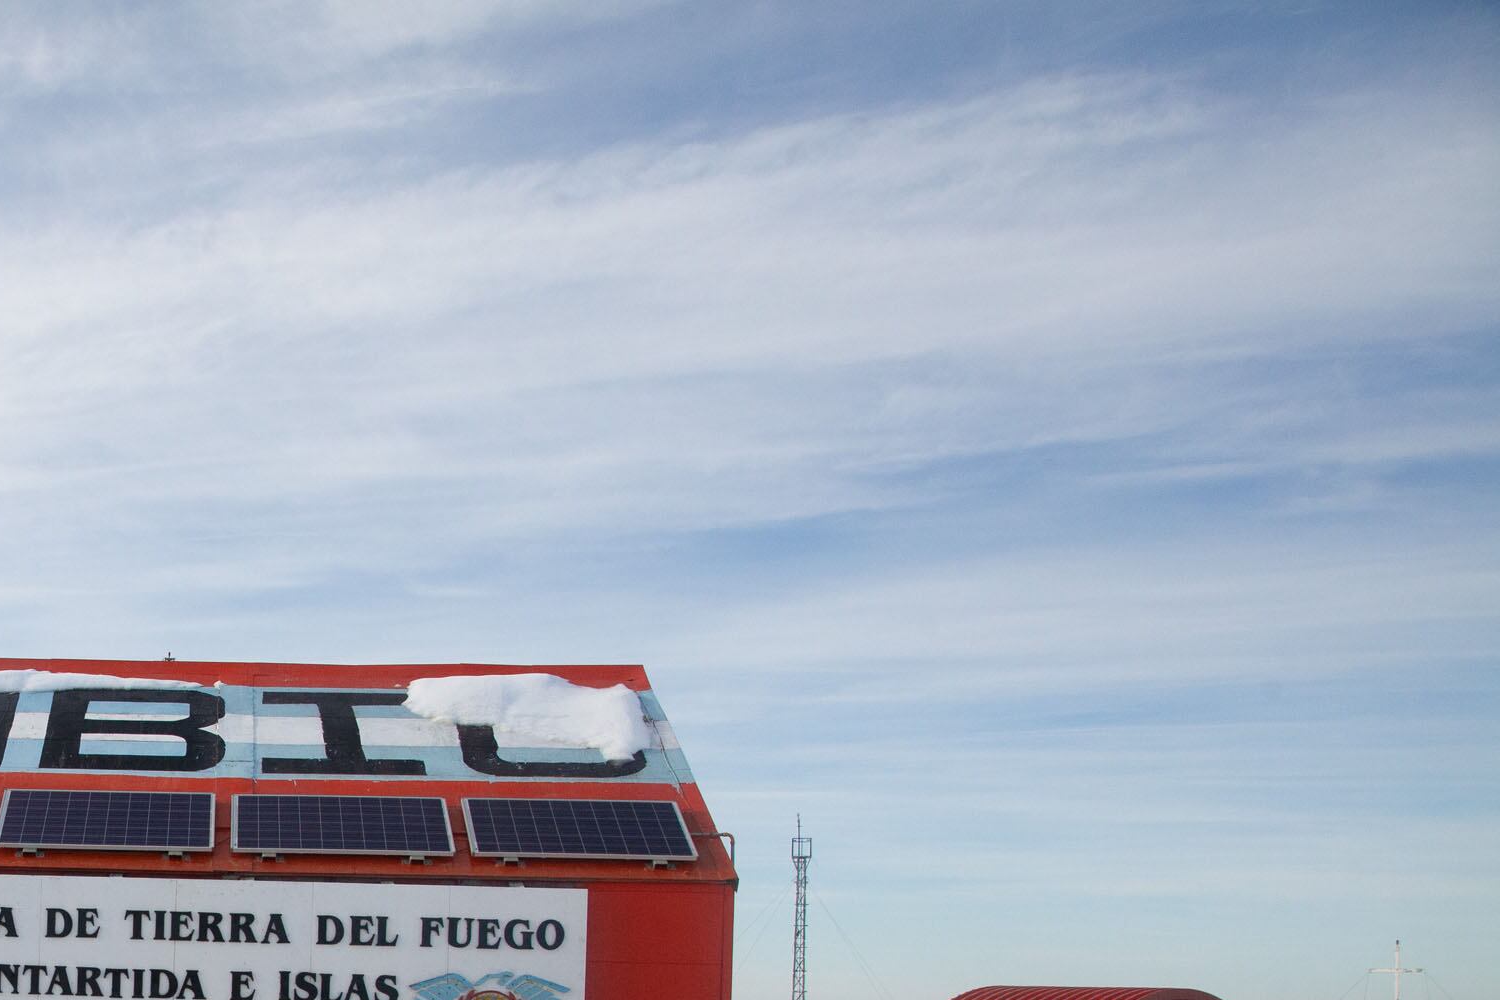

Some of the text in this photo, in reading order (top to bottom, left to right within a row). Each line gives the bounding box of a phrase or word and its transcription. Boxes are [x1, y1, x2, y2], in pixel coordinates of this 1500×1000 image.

[45, 907, 102, 939] DE
[123, 908, 291, 945] TIERRA
[316, 913, 400, 948] DEL
[419, 916, 567, 952] FUEGO
